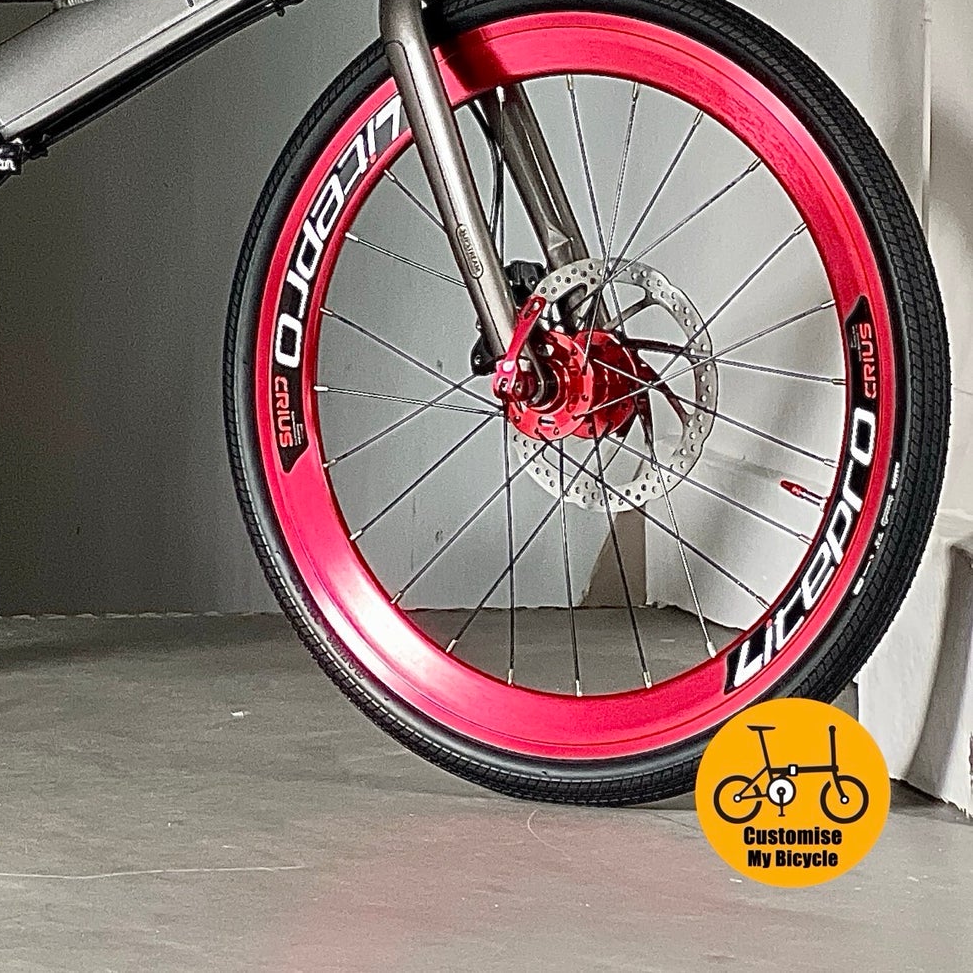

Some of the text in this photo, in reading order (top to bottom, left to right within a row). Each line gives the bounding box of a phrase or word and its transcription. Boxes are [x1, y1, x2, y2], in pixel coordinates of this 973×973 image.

[274, 94, 403, 368] Litepro
[275, 376, 293, 448] CRIUS
[859, 323, 876, 399] CRIUS
[734, 407, 875, 687] Litepro
